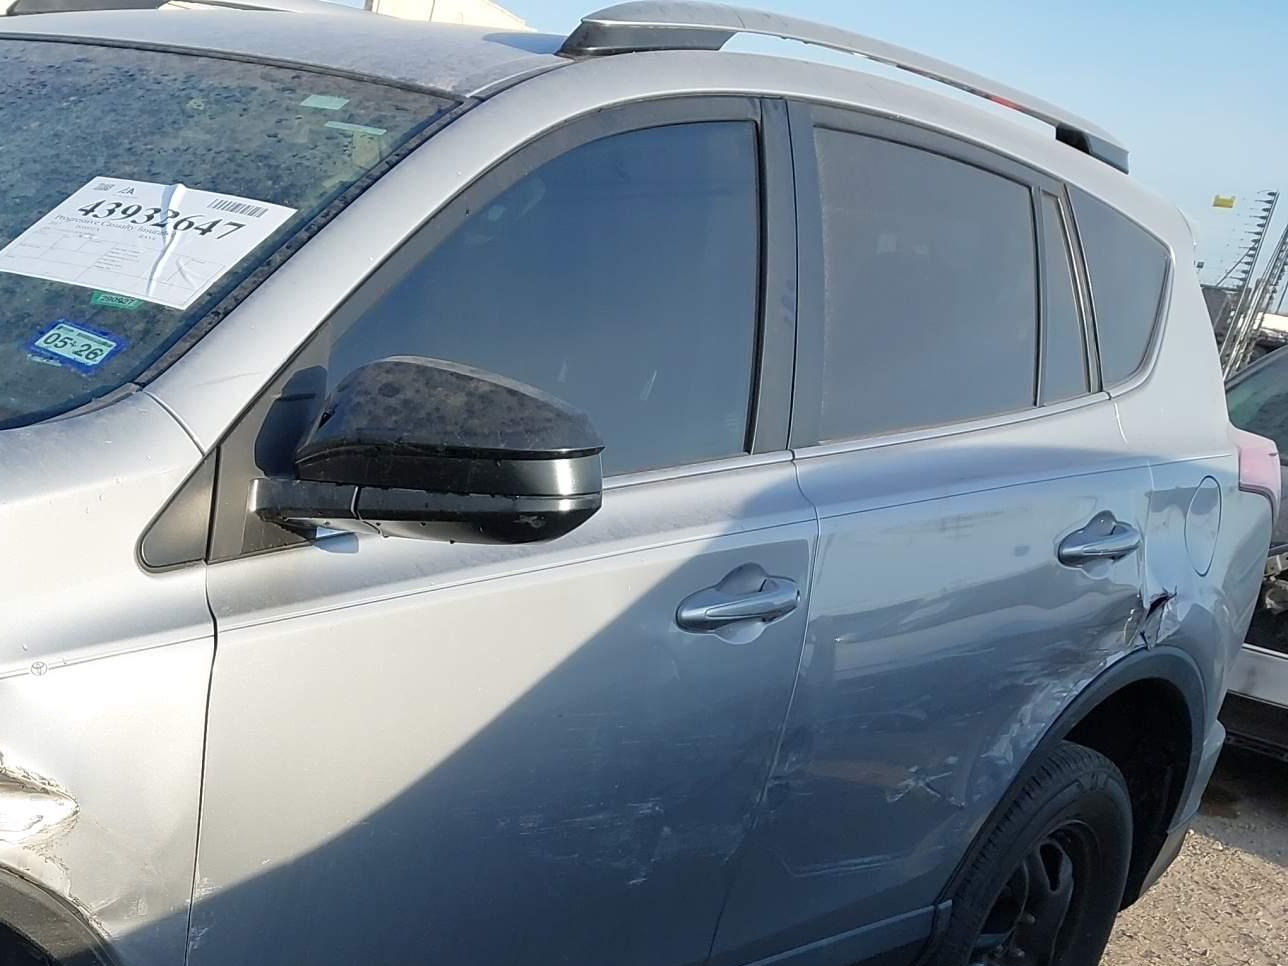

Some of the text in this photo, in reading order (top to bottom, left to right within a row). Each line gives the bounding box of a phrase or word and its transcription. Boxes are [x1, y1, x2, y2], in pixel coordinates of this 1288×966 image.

[77, 198, 247, 240] 43932647
[43, 332, 72, 349] 05
[72, 343, 104, 361] 26
